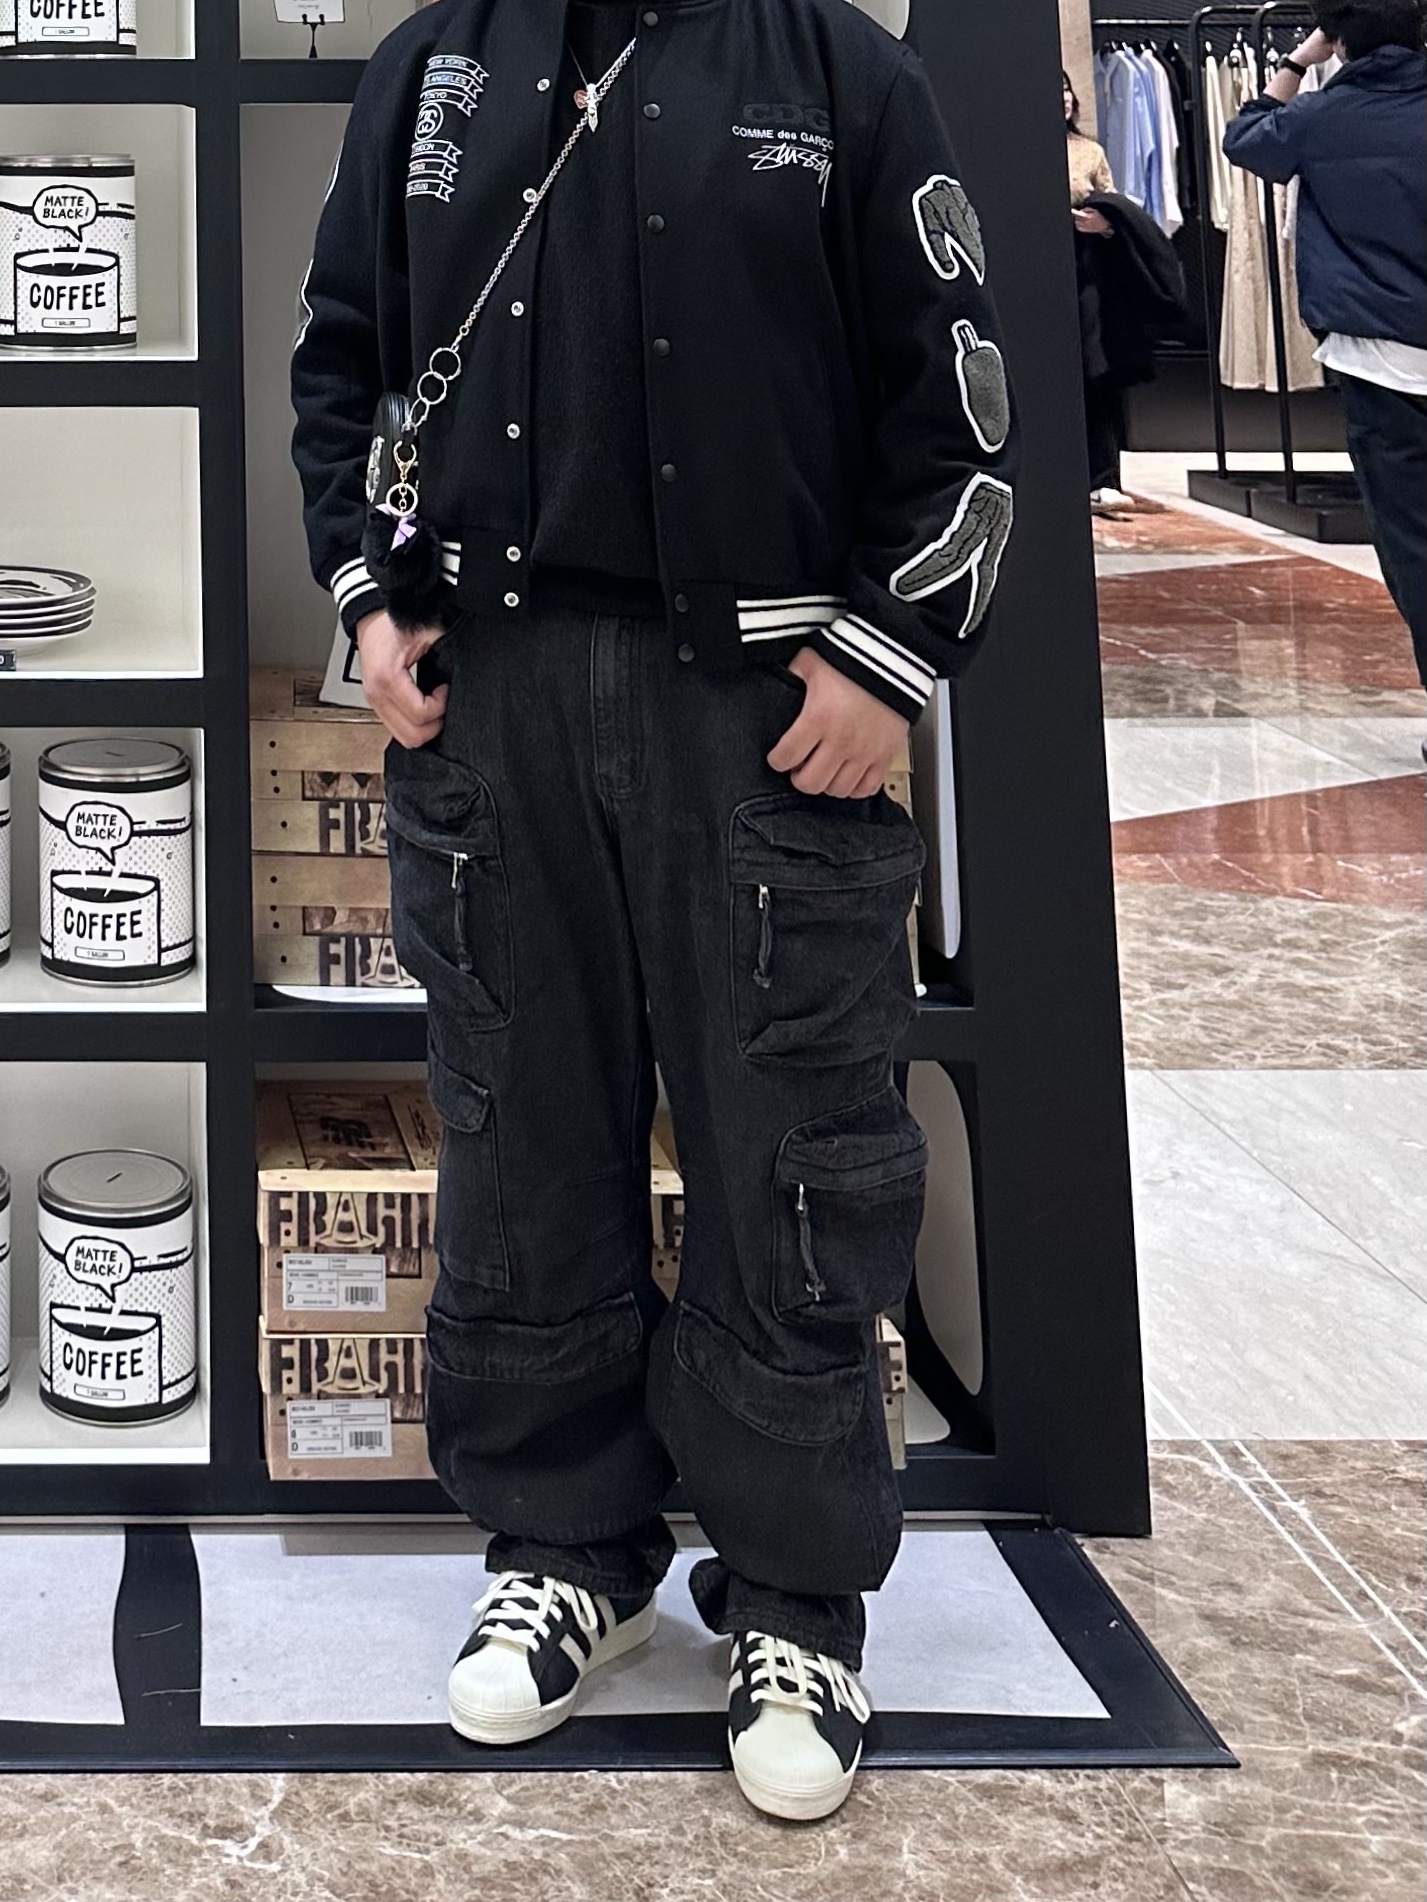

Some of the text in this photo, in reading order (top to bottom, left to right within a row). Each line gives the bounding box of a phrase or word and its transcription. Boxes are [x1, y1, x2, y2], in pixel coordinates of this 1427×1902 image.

[732, 125, 774, 139] COMME
[777, 129, 797, 140] des
[44, 196, 84, 207] MATTE
[43, 207, 89, 219] BLACK!
[30, 282, 106, 311] COFFEE
[77, 812, 117, 826] MATTE
[75, 825, 122, 840] BLACK!
[64, 907, 143, 941] COFFEE
[76, 1246, 121, 1262] MATTE
[74, 1259, 123, 1276] BLACK!
[63, 1342, 143, 1380] COFFEE
